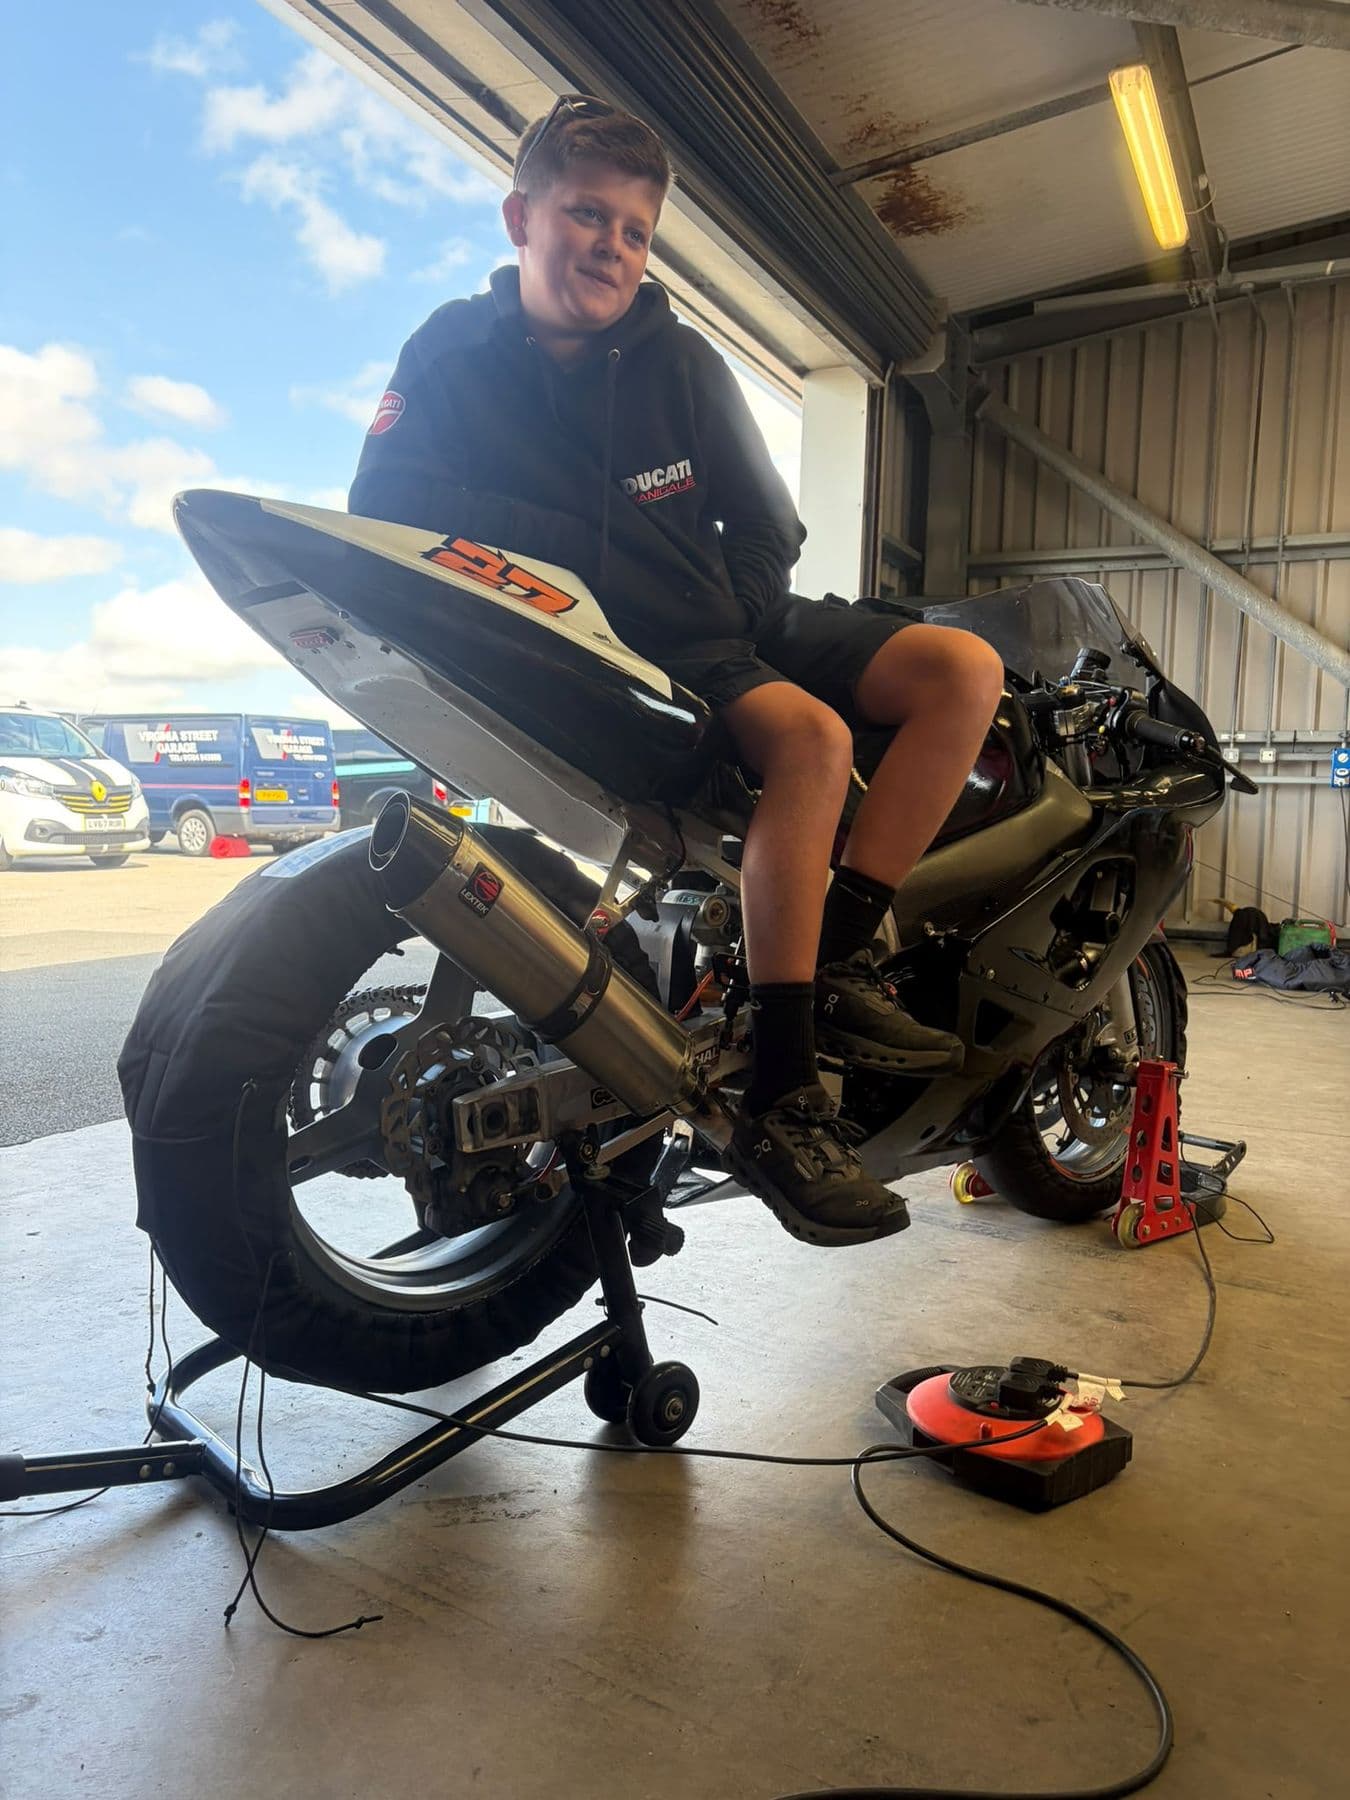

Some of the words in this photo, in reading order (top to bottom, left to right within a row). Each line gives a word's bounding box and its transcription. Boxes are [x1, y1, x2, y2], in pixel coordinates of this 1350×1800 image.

[622, 459, 692, 496] DUCATI
[421, 537, 579, 617] 27
[180, 729, 218, 741] STREET
[461, 888, 490, 914] LEXTEK
